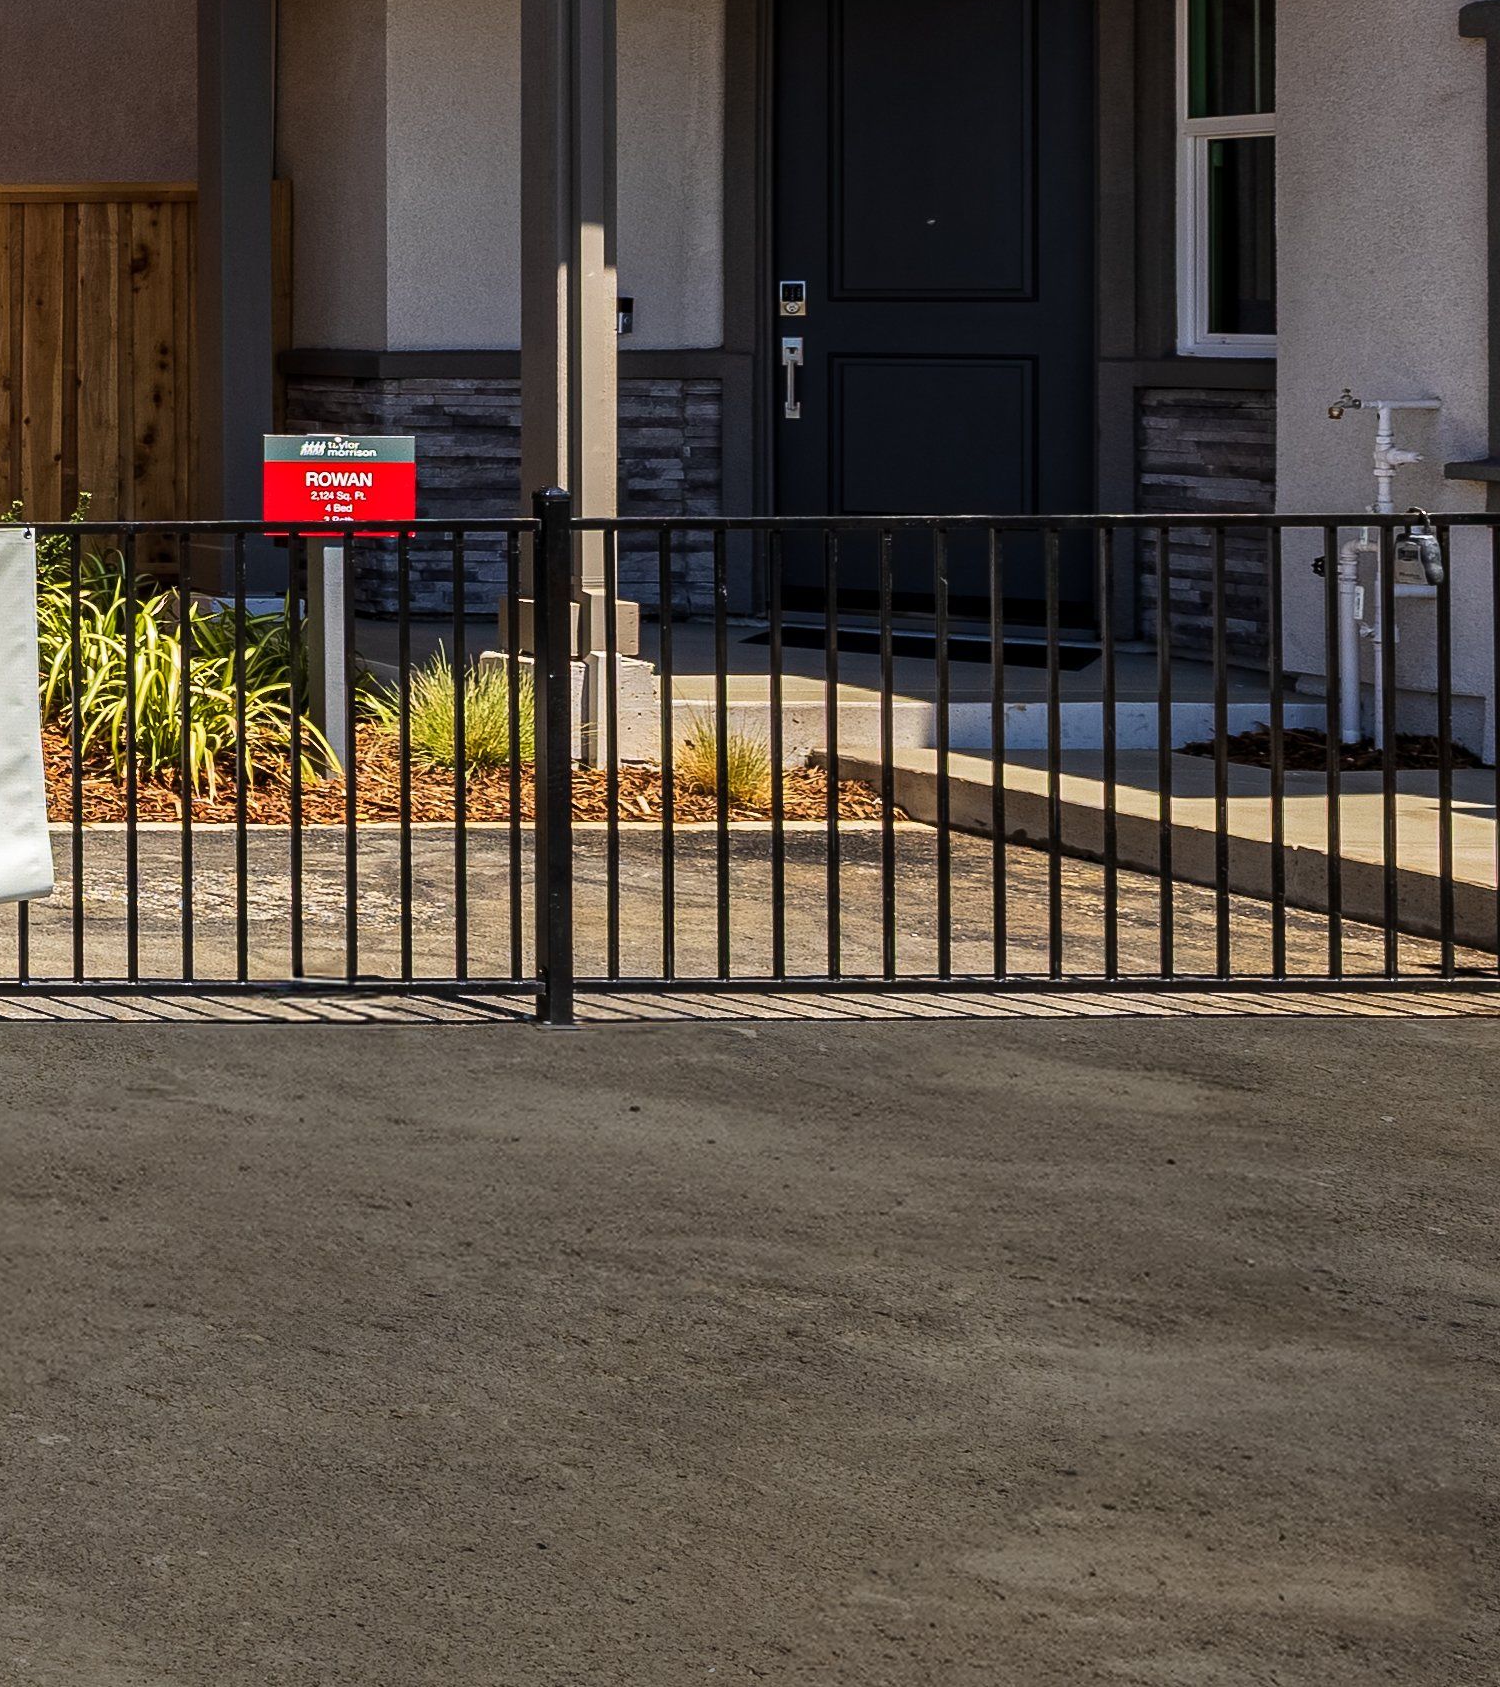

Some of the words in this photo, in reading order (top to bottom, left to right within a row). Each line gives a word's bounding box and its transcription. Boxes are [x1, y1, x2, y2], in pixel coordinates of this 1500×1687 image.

[328, 449, 377, 457] morrison
[305, 471, 373, 487] ROWAN
[310, 491, 335, 501] 2,124
[336, 491, 352, 501] Sq.
[324, 504, 332, 513] 4
[333, 503, 353, 513] Bed
